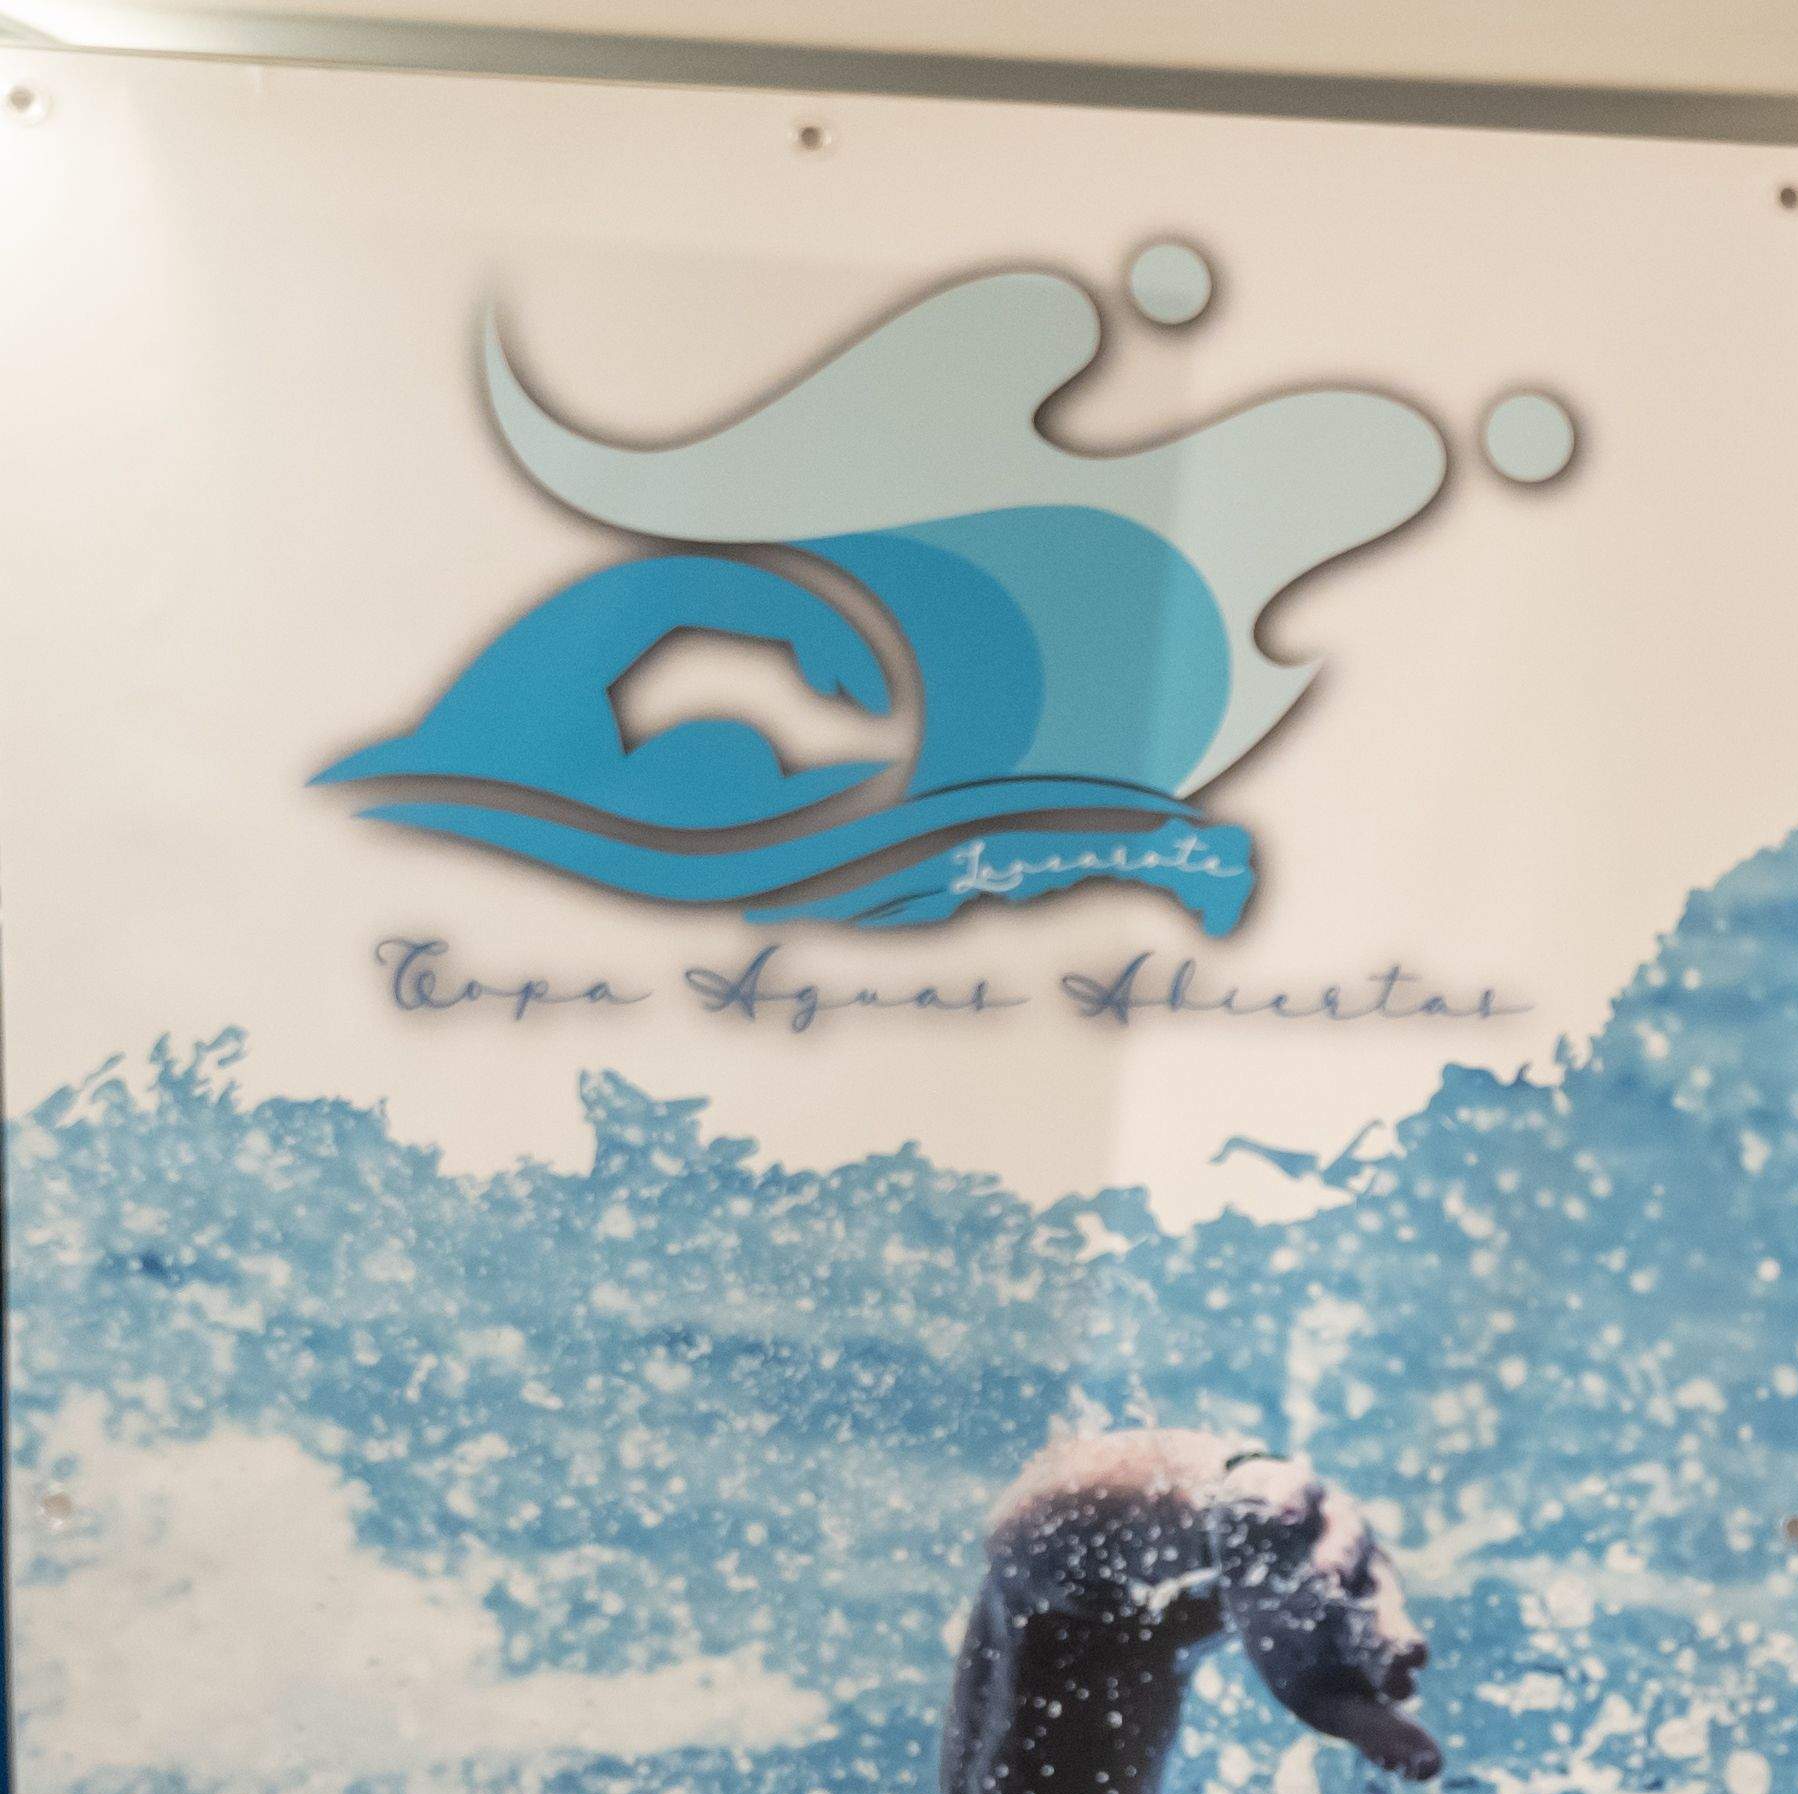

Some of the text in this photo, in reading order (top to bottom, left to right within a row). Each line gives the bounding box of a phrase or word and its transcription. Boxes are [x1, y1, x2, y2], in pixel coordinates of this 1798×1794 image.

[374, 937, 1534, 1034] Copa Aguas Abiertas
